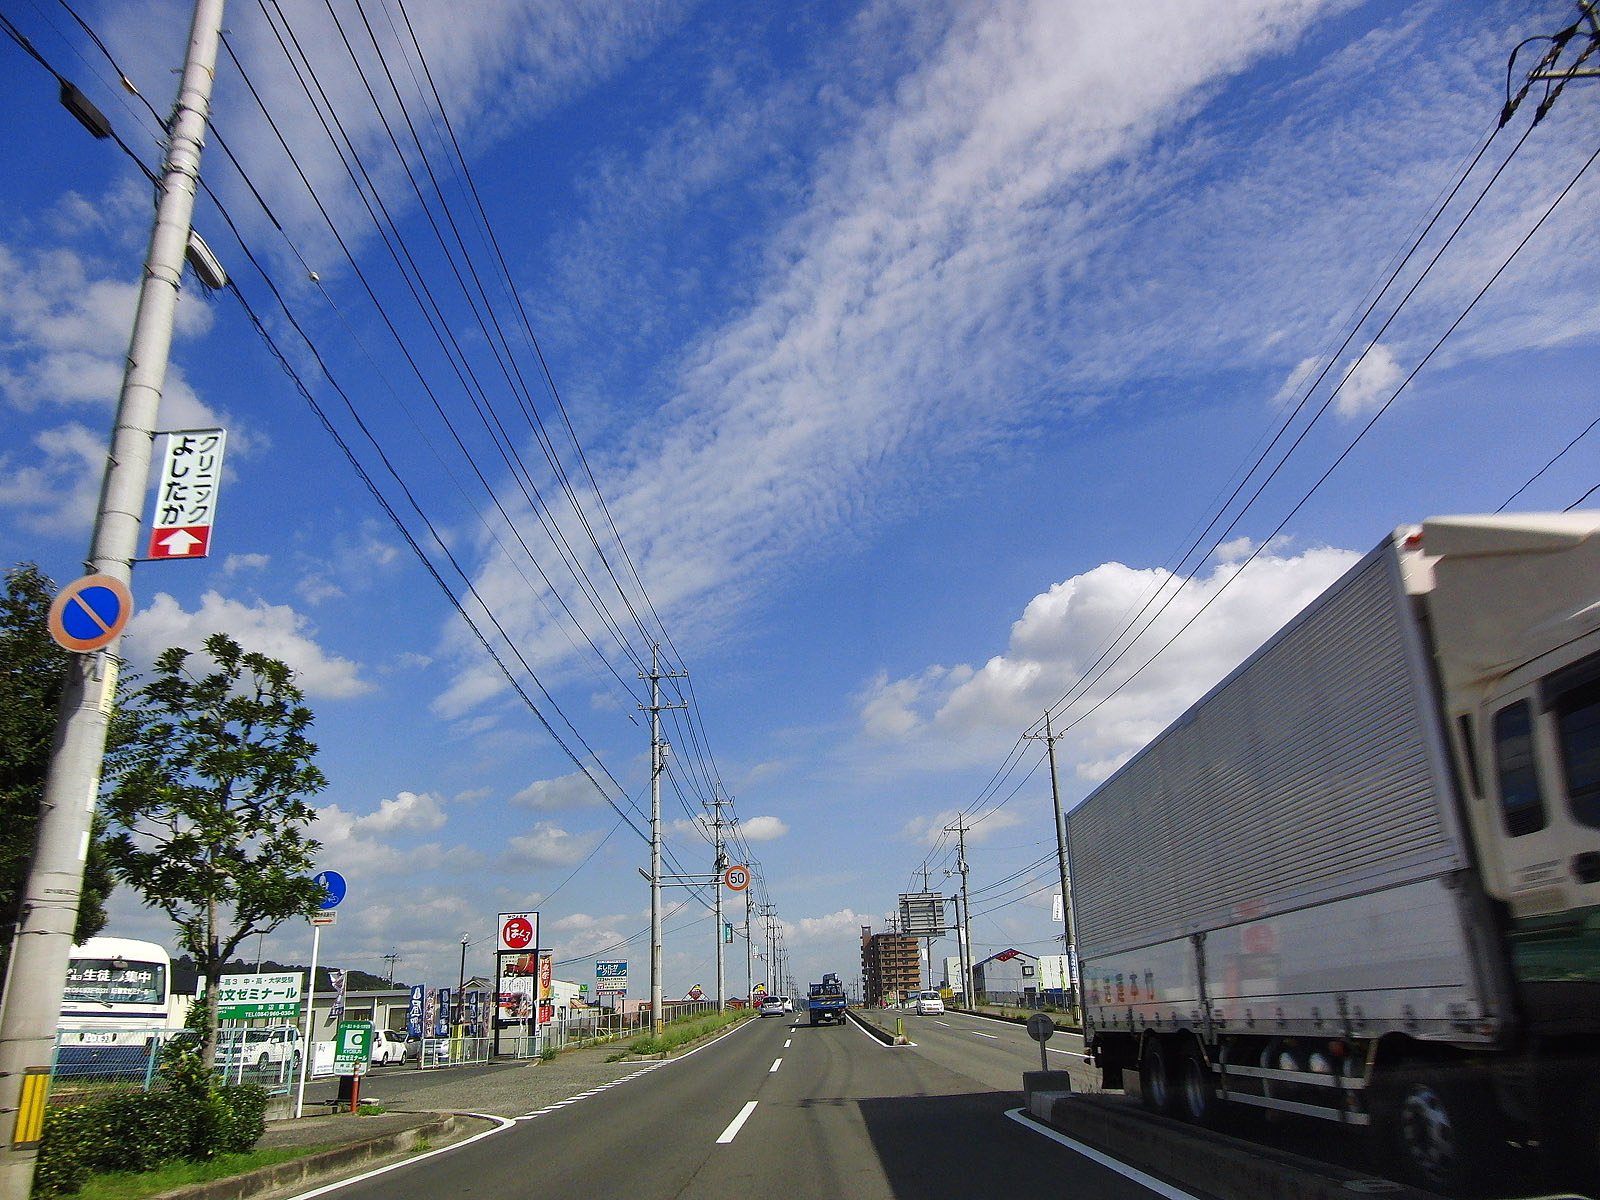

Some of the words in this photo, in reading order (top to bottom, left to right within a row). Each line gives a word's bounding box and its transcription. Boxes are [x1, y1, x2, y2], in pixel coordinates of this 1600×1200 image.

[161, 436, 196, 525] よしたか
[188, 436, 219, 524] クリニック
[730, 872, 745, 884] 50
